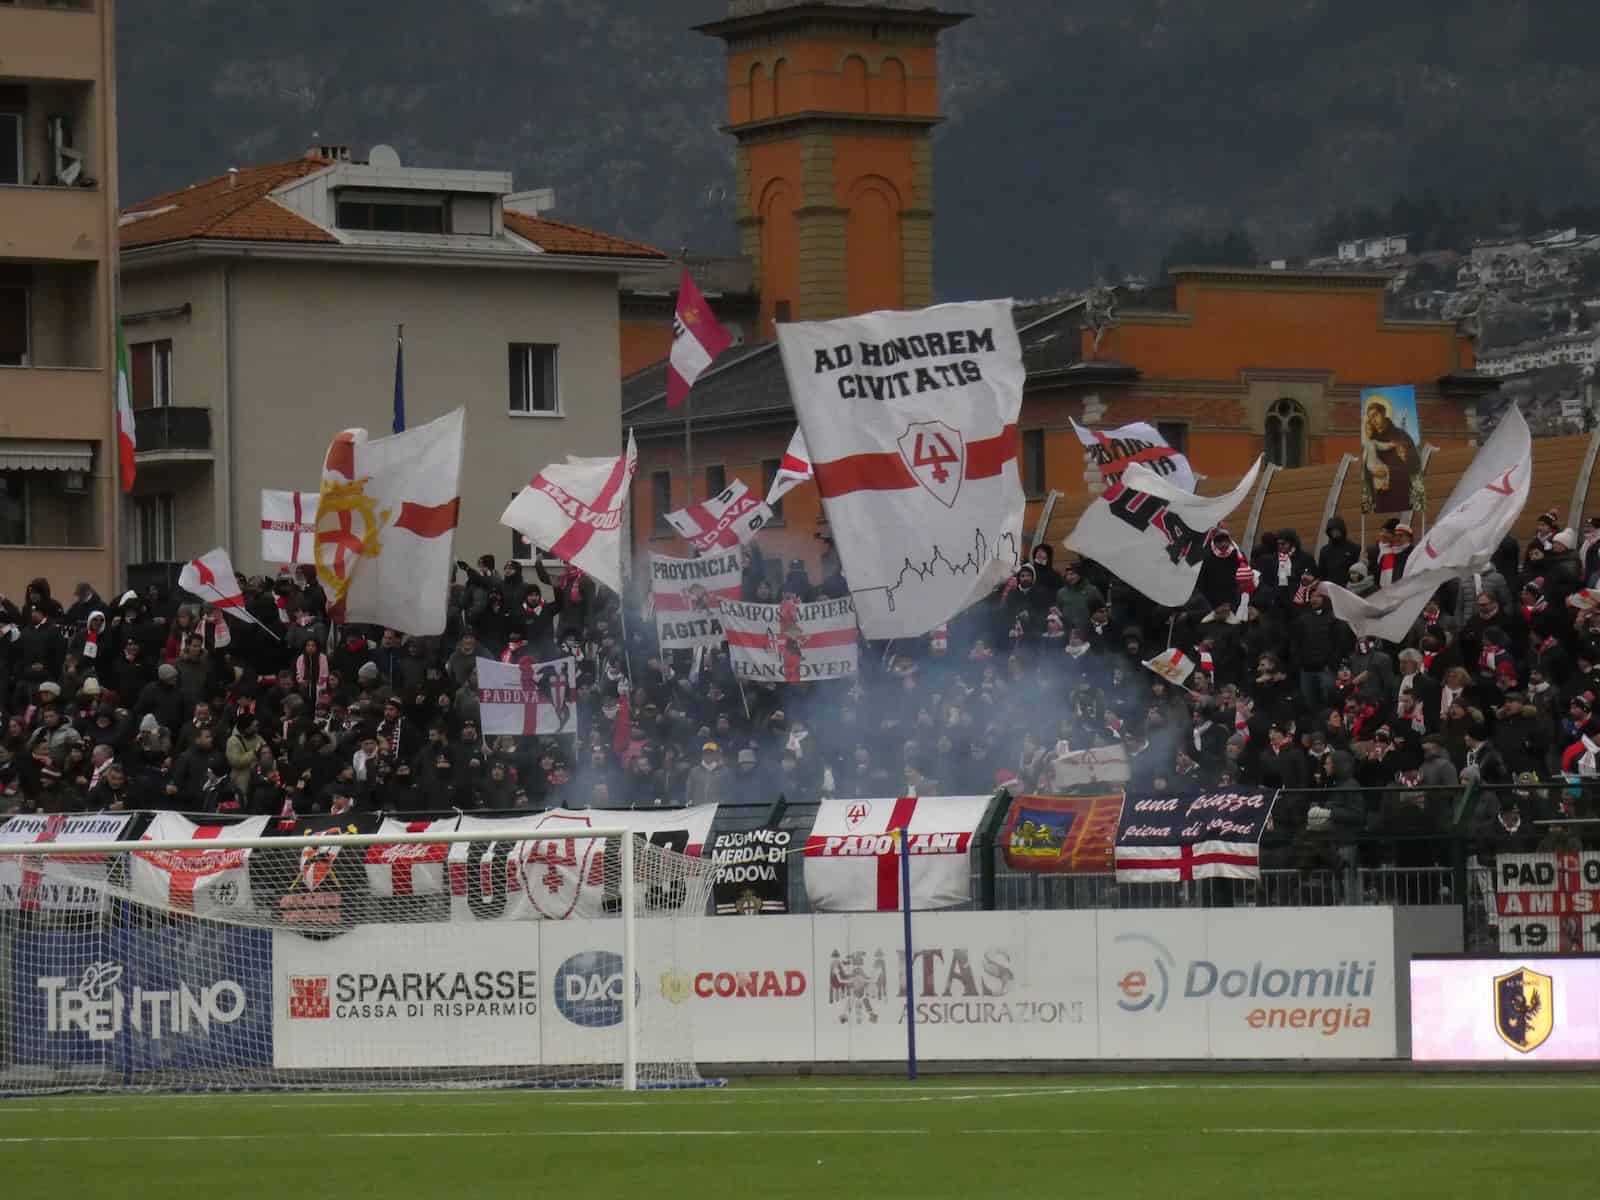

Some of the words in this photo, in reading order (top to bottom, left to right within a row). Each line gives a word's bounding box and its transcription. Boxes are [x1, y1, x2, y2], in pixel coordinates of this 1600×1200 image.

[814, 343, 853, 374] AD
[857, 327, 996, 368] HONOREM
[836, 359, 982, 400] CIVITATIS
[652, 554, 740, 580] PROVINCIA
[1134, 797, 1179, 812] una
[1185, 793, 1265, 817] piazza
[715, 830, 791, 848] EUGANEO
[1121, 823, 1172, 841] piena
[1181, 821, 1203, 837] di
[711, 845, 767, 865] MERDA
[767, 847, 787, 864] DI
[822, 833, 961, 857] PADOANI
[716, 864, 778, 885] PADOVA
[1509, 922, 1548, 947] 19
[693, 970, 807, 999] CONAD
[895, 947, 1014, 998] ITAS
[1183, 960, 1377, 998] Dolomiti
[336, 970, 538, 1002] SPARKASSE
[37, 975, 247, 1040] TRENTINO
[336, 1003, 398, 1019] CASSA
[408, 1003, 424, 1018] DI
[433, 1001, 538, 1018] RISPARMIO
[1246, 1002, 1371, 1036] energia
